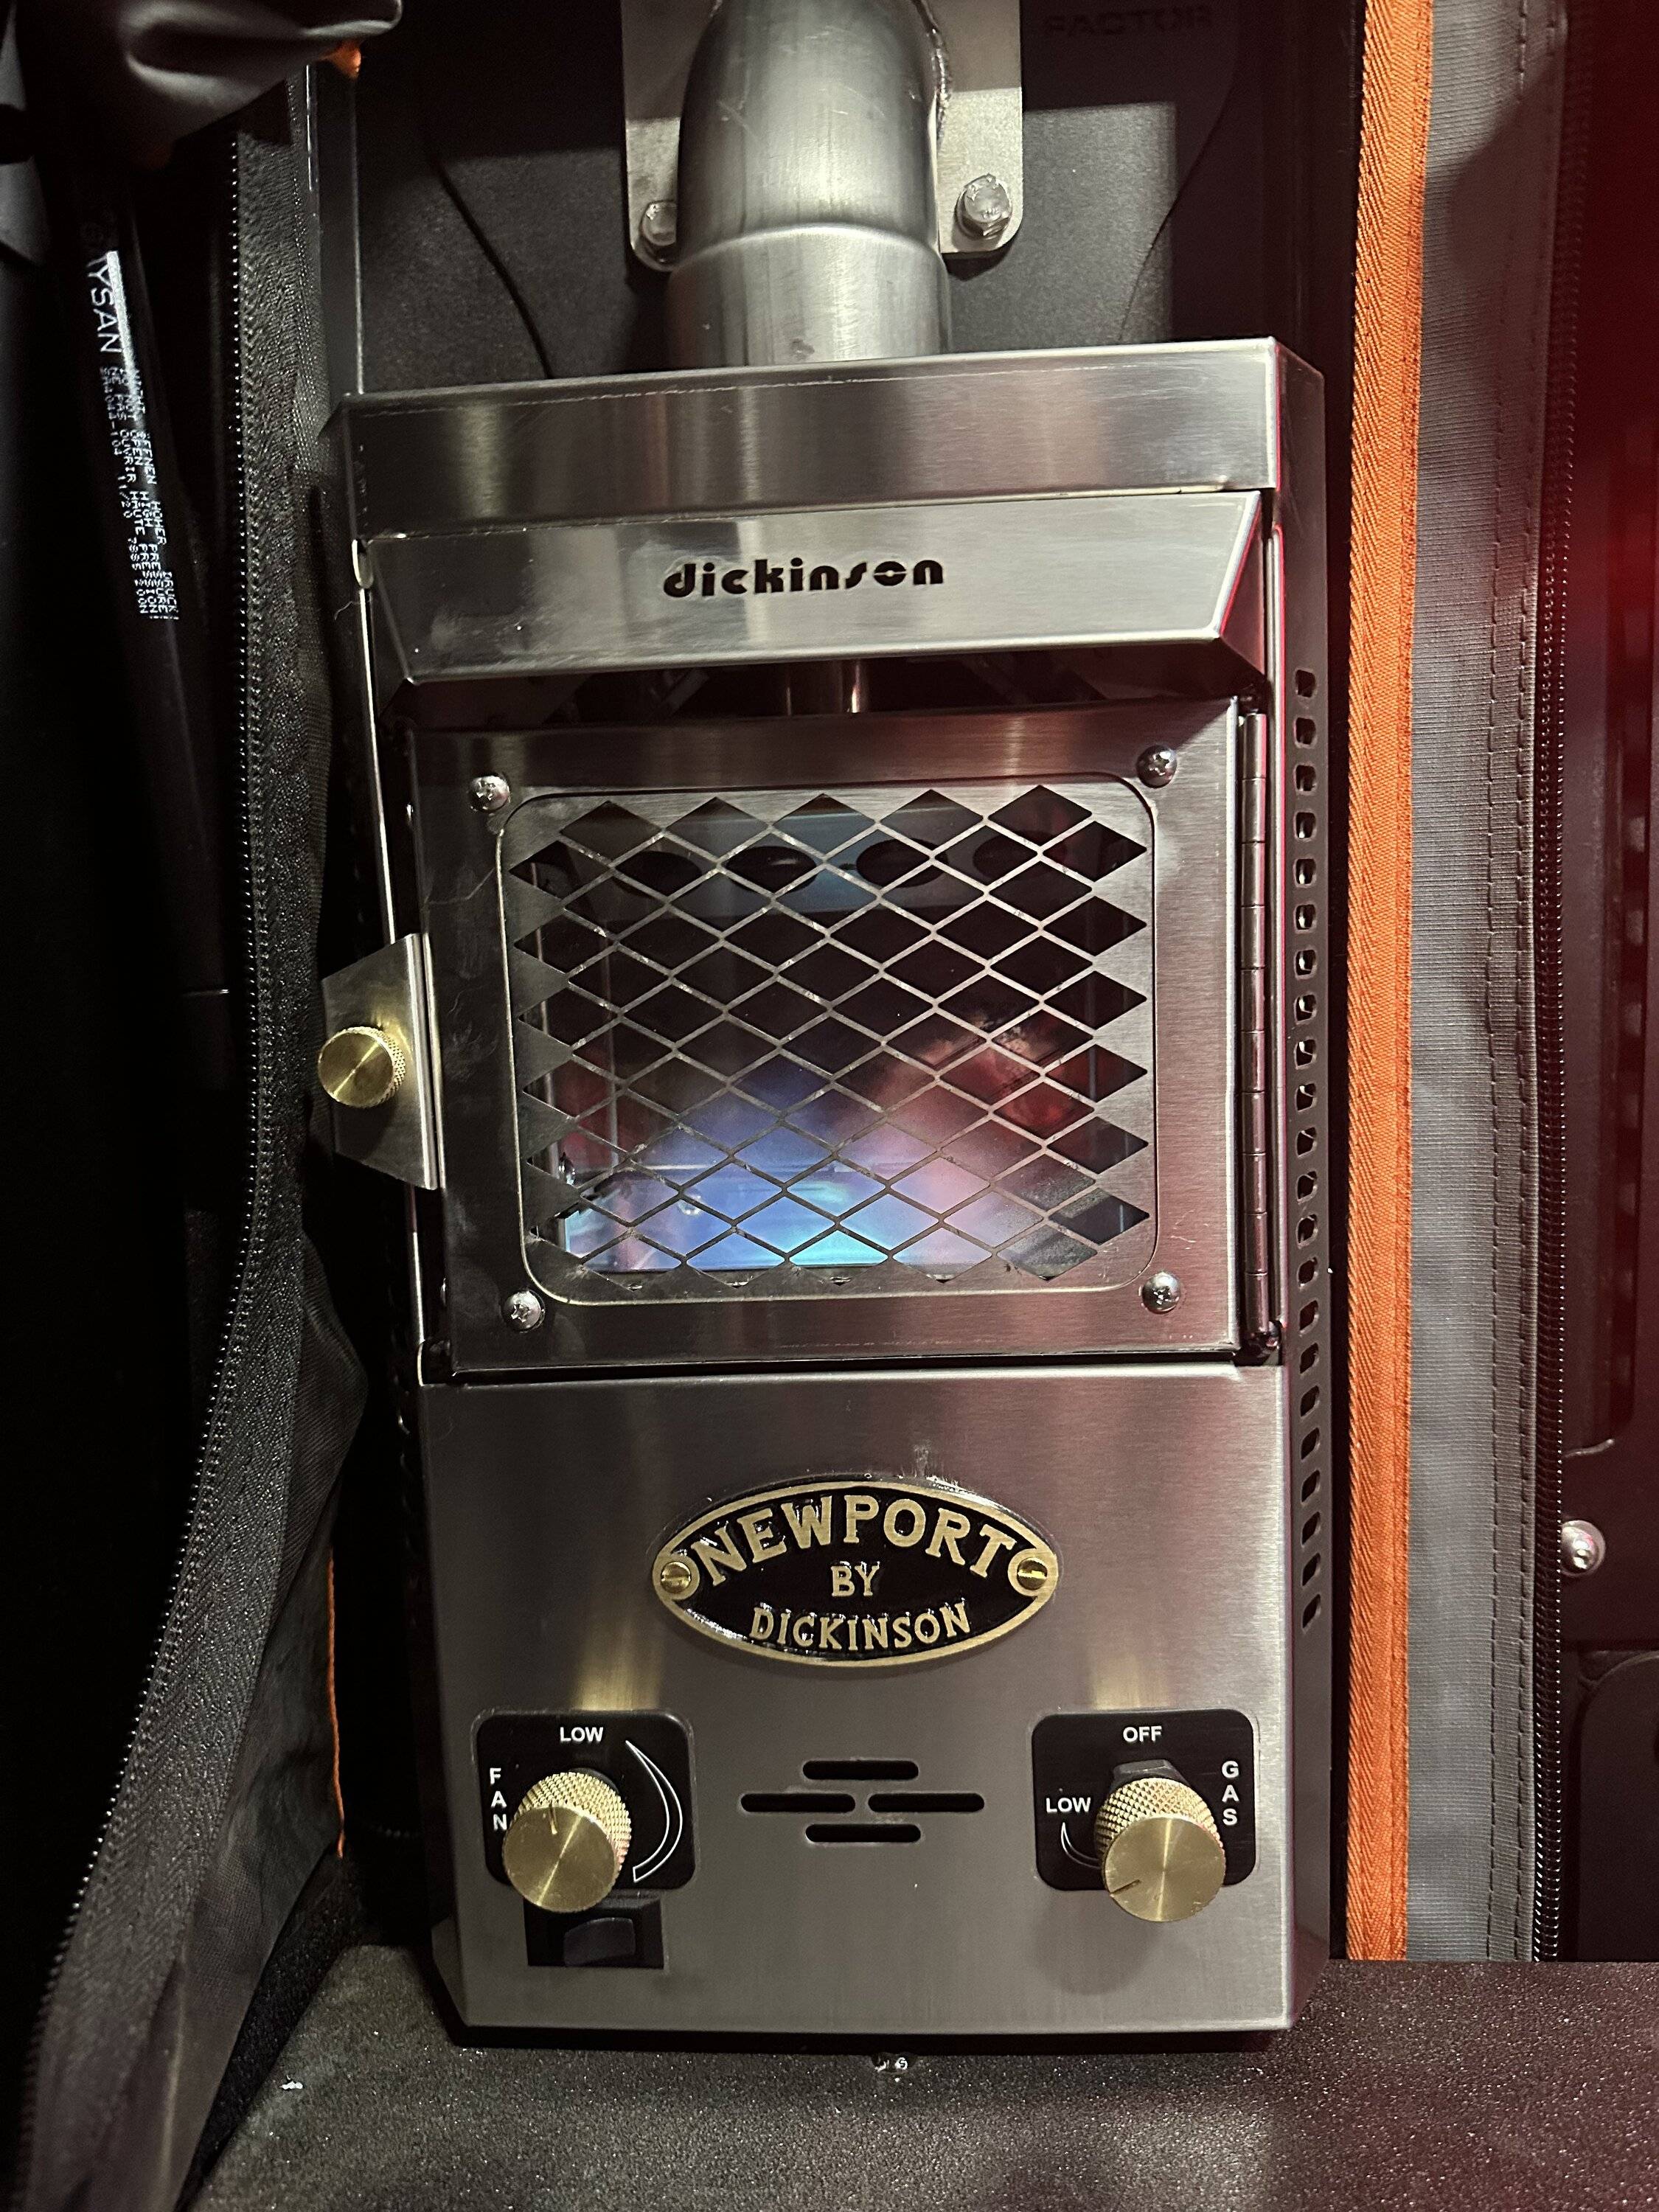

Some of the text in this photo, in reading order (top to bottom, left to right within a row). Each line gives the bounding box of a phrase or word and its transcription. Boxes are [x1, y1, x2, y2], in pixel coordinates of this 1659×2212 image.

[1043, 6, 1213, 37] FACTOR
[119, 430, 136, 483] OUVRIR
[129, 491, 145, 535] HAUTE
[139, 492, 153, 527] HIGH
[150, 501, 167, 545] HOHER
[664, 557, 944, 597] dickinson
[690, 1495, 1018, 1587] NEWPORT
[830, 1561, 881, 1598] BY
[750, 1600, 971, 1651] DICKINSON
[560, 1726, 603, 1743] LOW
[1123, 1725, 1163, 1742] OFF
[490, 1767, 507, 1831] FAN
[1046, 1796, 1091, 1814] LOW
[1222, 1760, 1239, 1826] GAS
